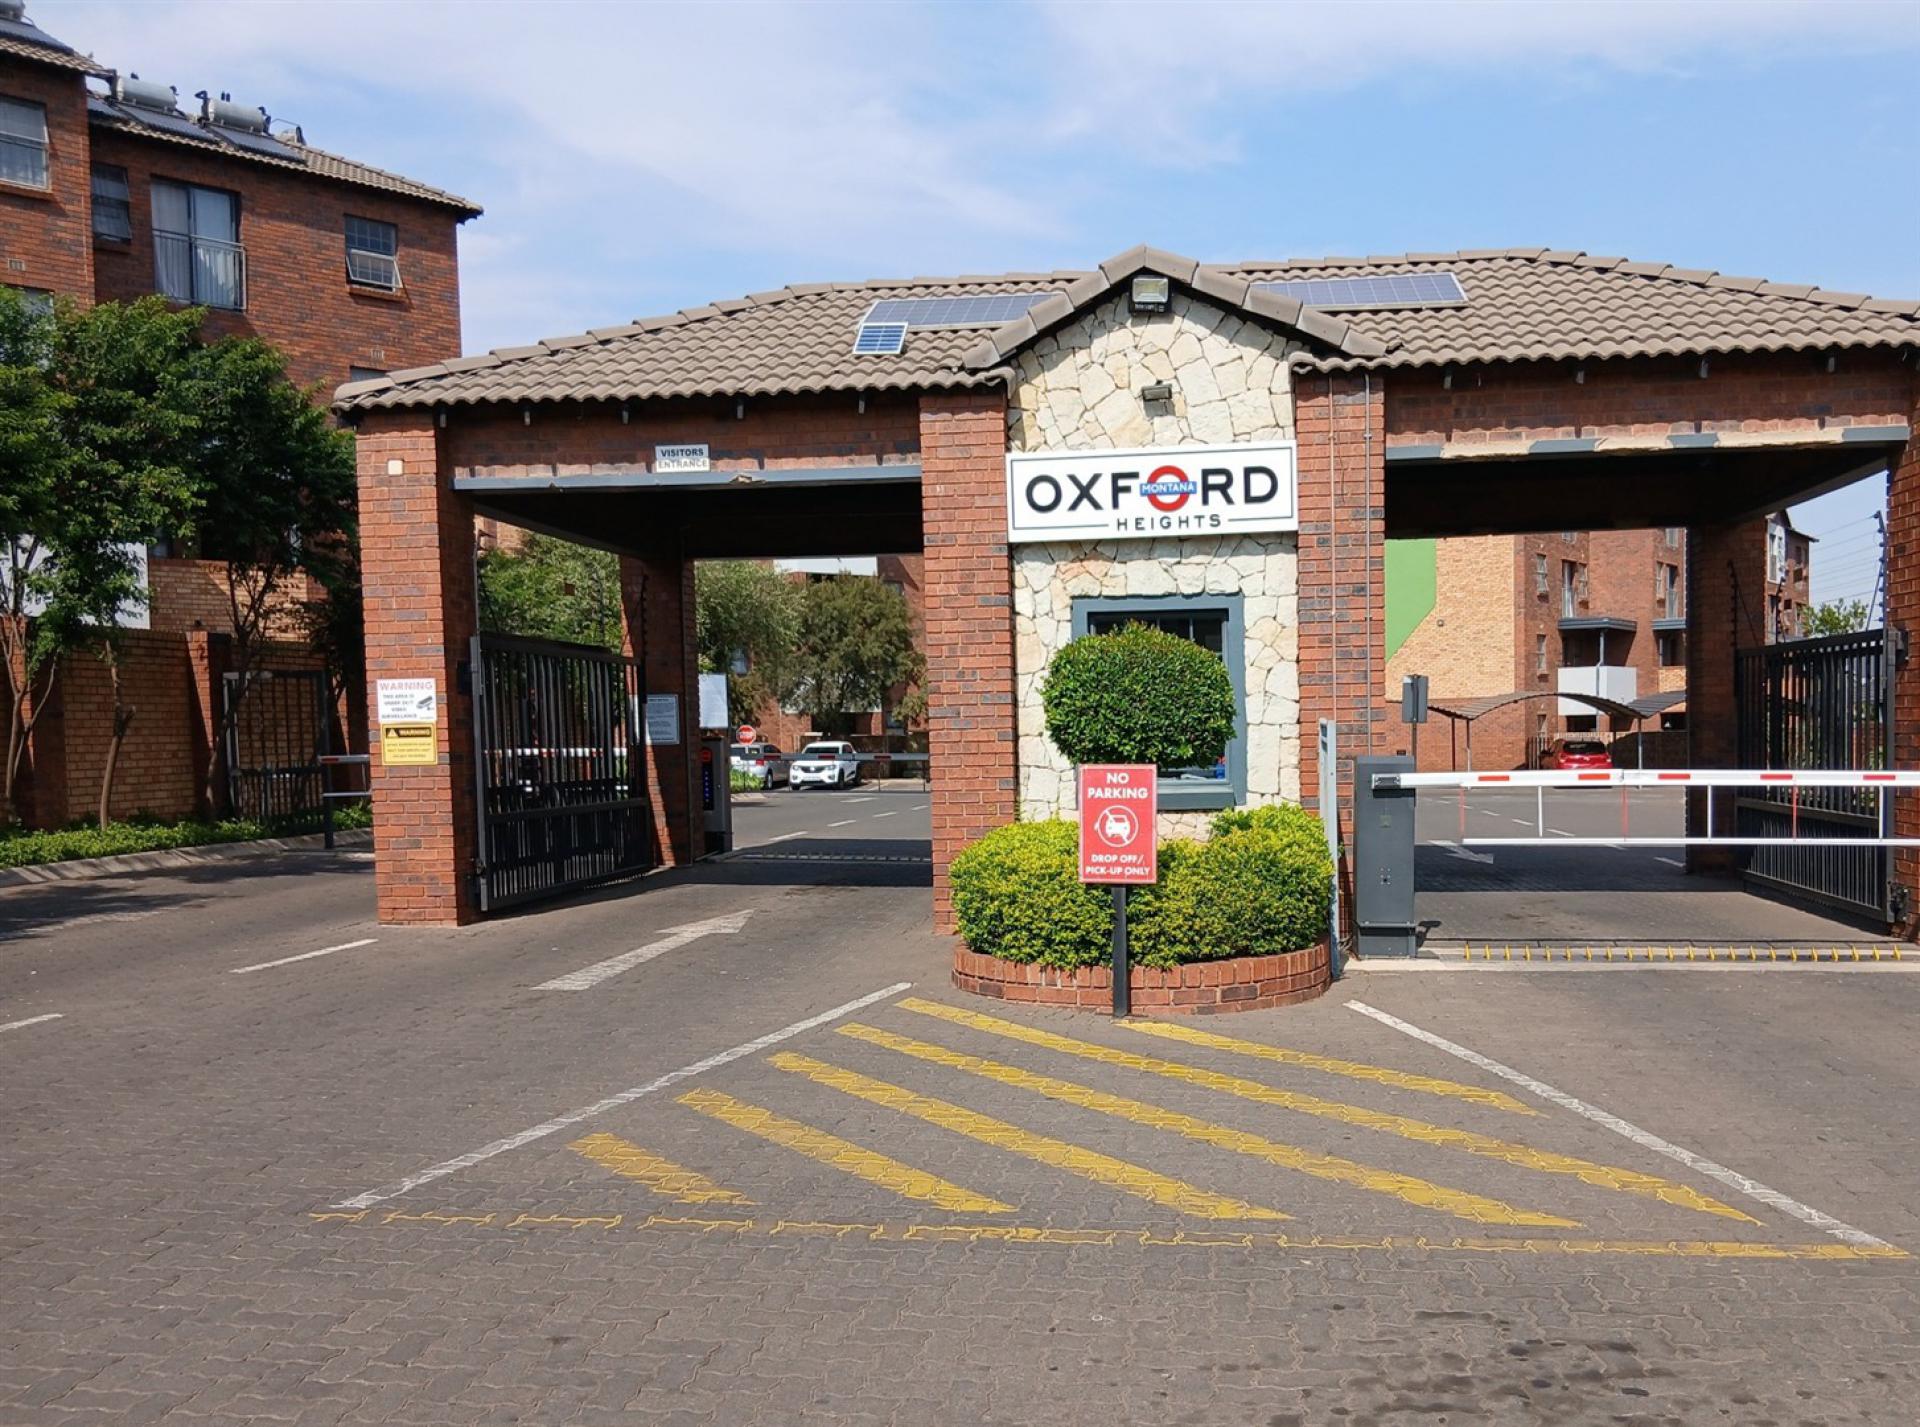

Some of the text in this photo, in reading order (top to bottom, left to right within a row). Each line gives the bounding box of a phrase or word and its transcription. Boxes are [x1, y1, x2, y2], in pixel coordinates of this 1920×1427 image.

[661, 448, 704, 457] VISITORS
[659, 459, 708, 469] ENTRANCE
[1025, 465, 1279, 513] OXFORD
[1142, 481, 1196, 495] MONTANA
[1117, 514, 1222, 531] HEIGHTS
[380, 681, 432, 690] WARNING
[1106, 772, 1130, 784] NO
[1087, 786, 1149, 799] PARKING
[1091, 854, 1144, 864] DROP OFF/
[1085, 866, 1150, 875] PICK-UP ONLY
